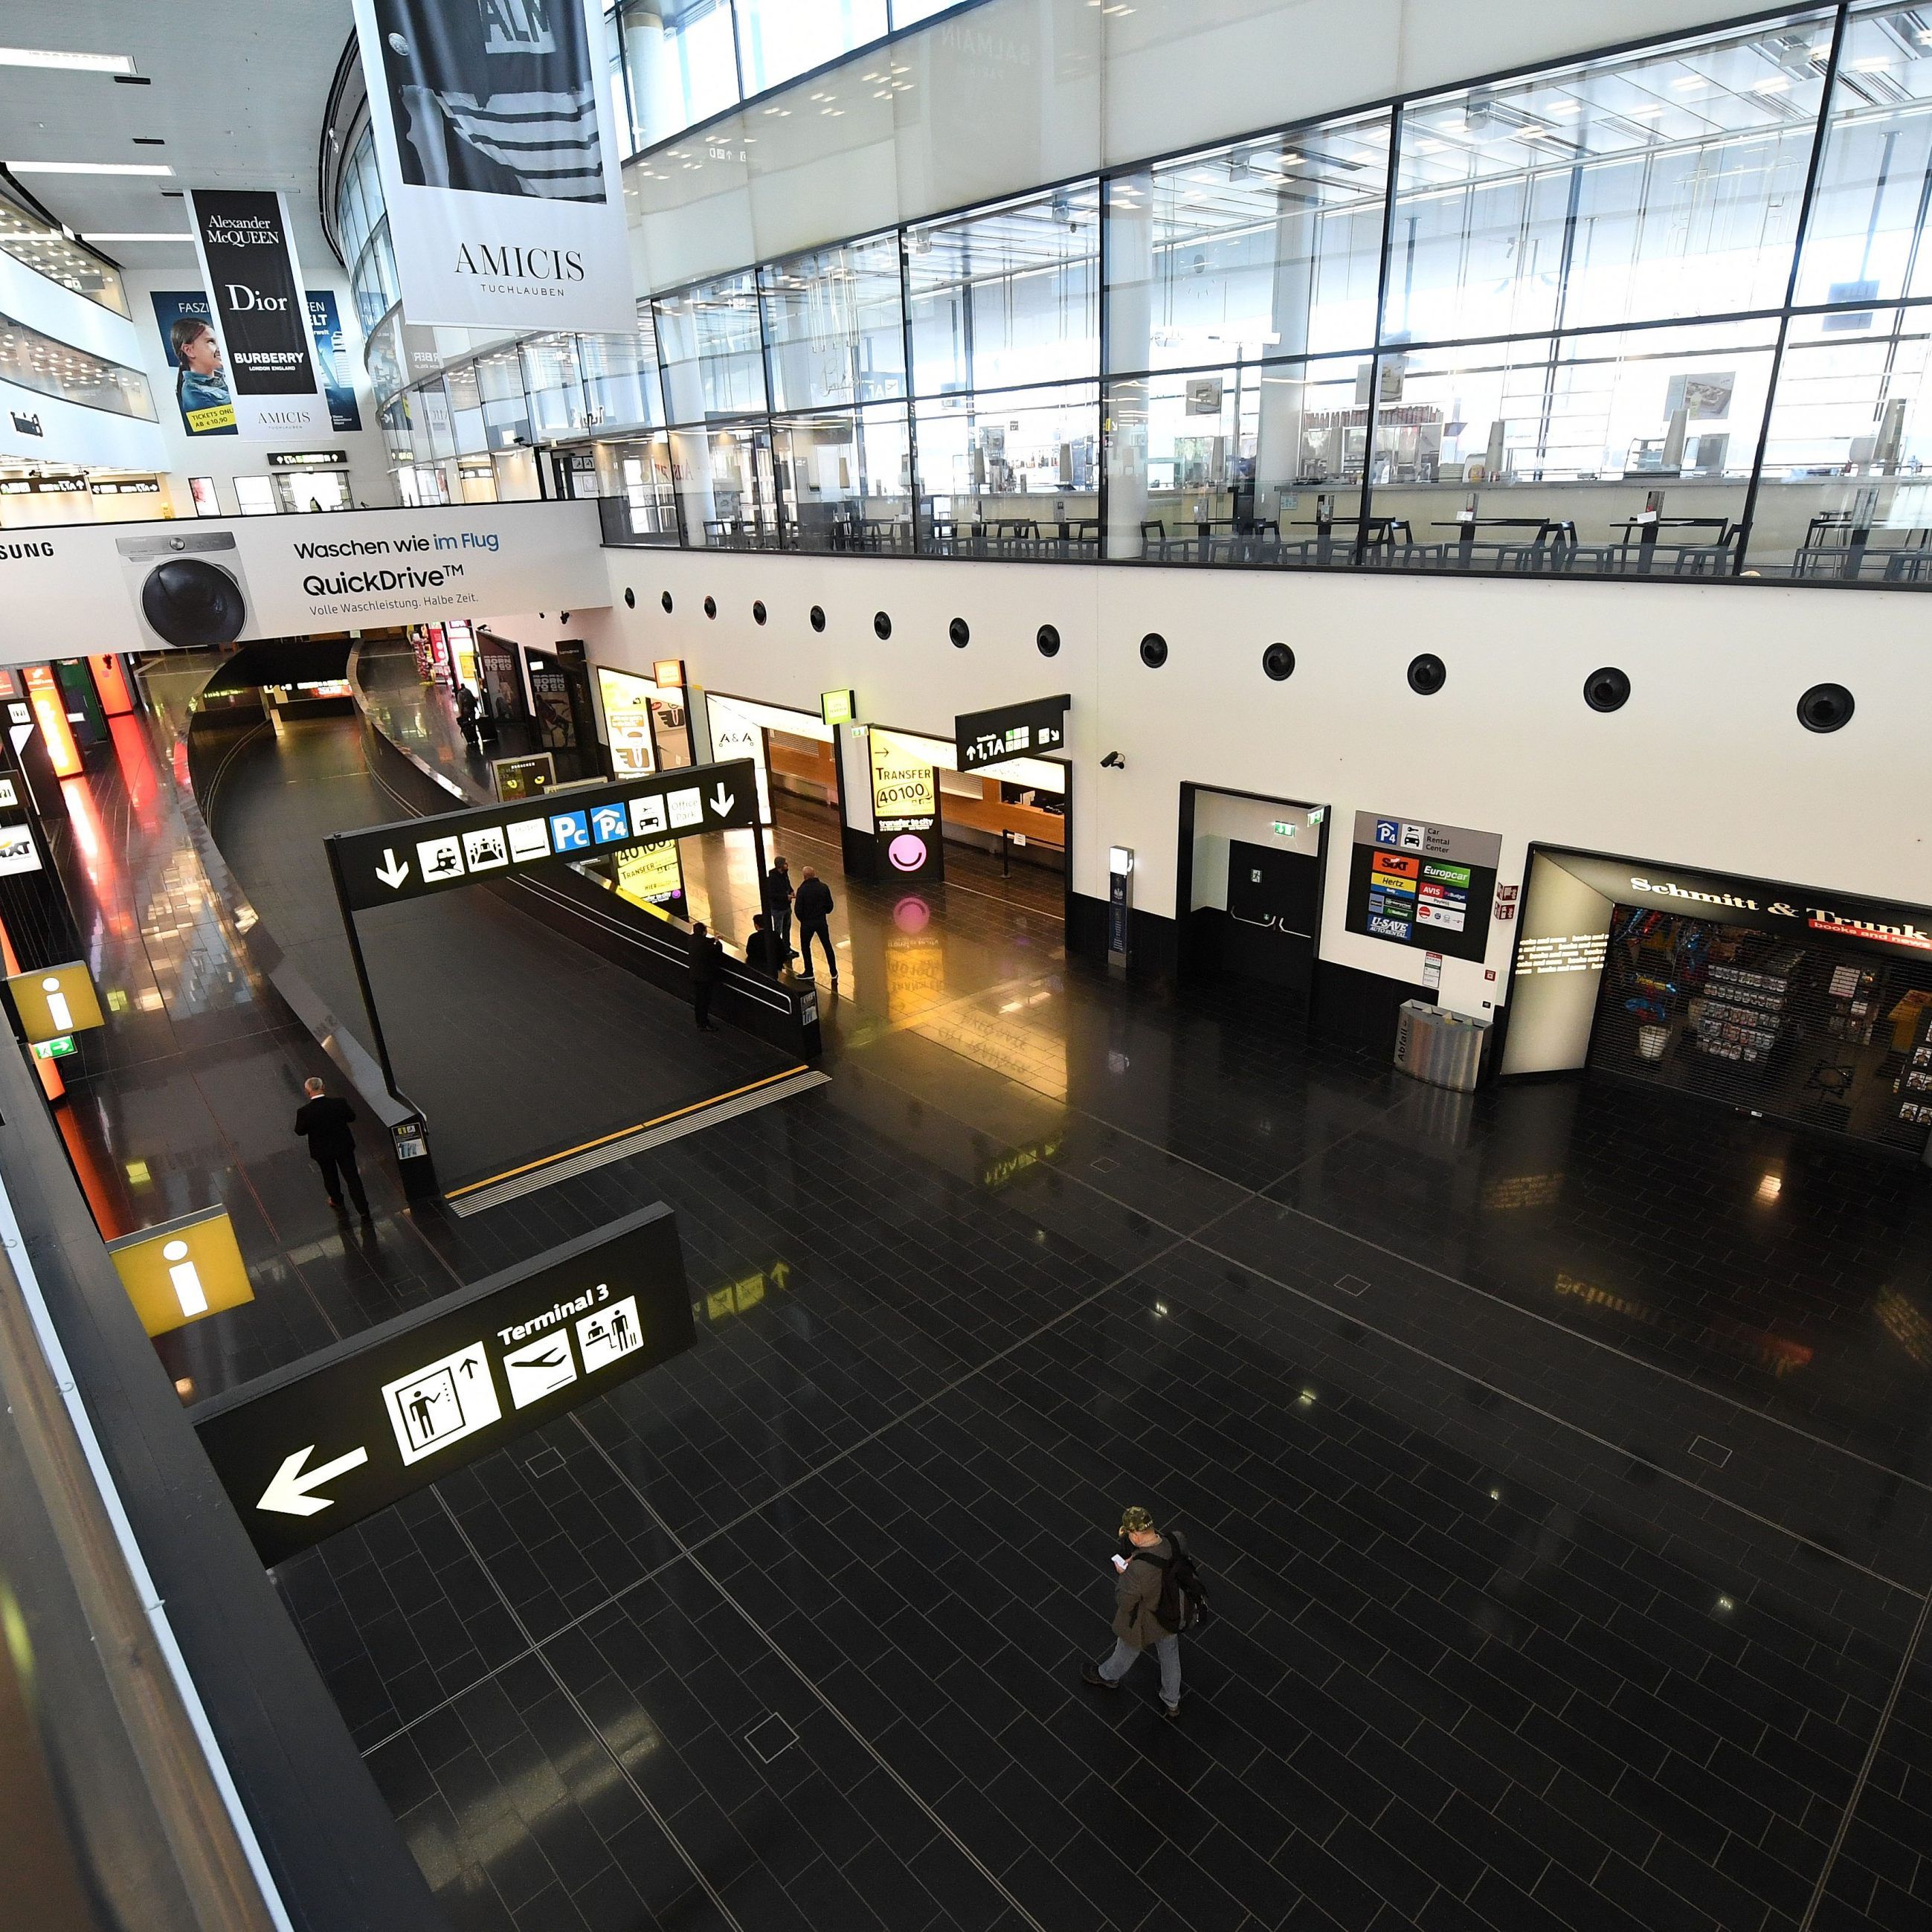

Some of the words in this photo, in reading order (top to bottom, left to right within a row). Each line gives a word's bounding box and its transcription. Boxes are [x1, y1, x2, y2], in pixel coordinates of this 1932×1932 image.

[209, 215, 271, 229] Alexander
[207, 230, 280, 247] McQUEEN
[454, 242, 585, 282] AMICIS
[480, 284, 564, 296] TUCHLAUBEN
[225, 284, 288, 311] Dior
[234, 352, 304, 364] BURBERRY
[192, 411, 218, 421] TICKETS
[258, 412, 311, 424] AMICIS
[294, 540, 390, 559] Waschen
[393, 535, 430, 553] wie
[434, 533, 458, 550] im
[461, 532, 500, 552] Flug
[309, 605, 338, 616] Volle
[340, 597, 422, 614] Waschleistung.
[424, 595, 454, 607] Halbe
[456, 593, 479, 603] Zeit.
[551, 683, 565, 692] GO
[720, 733, 730, 743] A
[732, 732, 738, 742] &
[742, 732, 752, 742] A
[976, 738, 1005, 760] 1,1A
[879, 783, 924, 803] 40100
[671, 799, 698, 811] Office
[676, 811, 696, 821] Park
[1426, 836, 1450, 846] Rental
[1426, 844, 1449, 854] Center
[1423, 865, 1468, 881] Europcar
[1382, 877, 1404, 887] Hertz
[1423, 886, 1440, 895] AVIS
[1630, 877, 1760, 911] Schmitt
[1768, 902, 1800, 918] &
[1806, 907, 1929, 941] Trunk
[1371, 916, 1408, 931] U-SAVE
[1369, 926, 1384, 934] AUTO
[1385, 929, 1407, 938] RENTAL
[1814, 921, 1858, 935] books
[1861, 931, 1888, 941] and
[1891, 936, 1931, 949] news
[1398, 1028, 1408, 1061] Abfall
[497, 1289, 595, 1346] Terminal
[596, 1284, 609, 1301] 3
